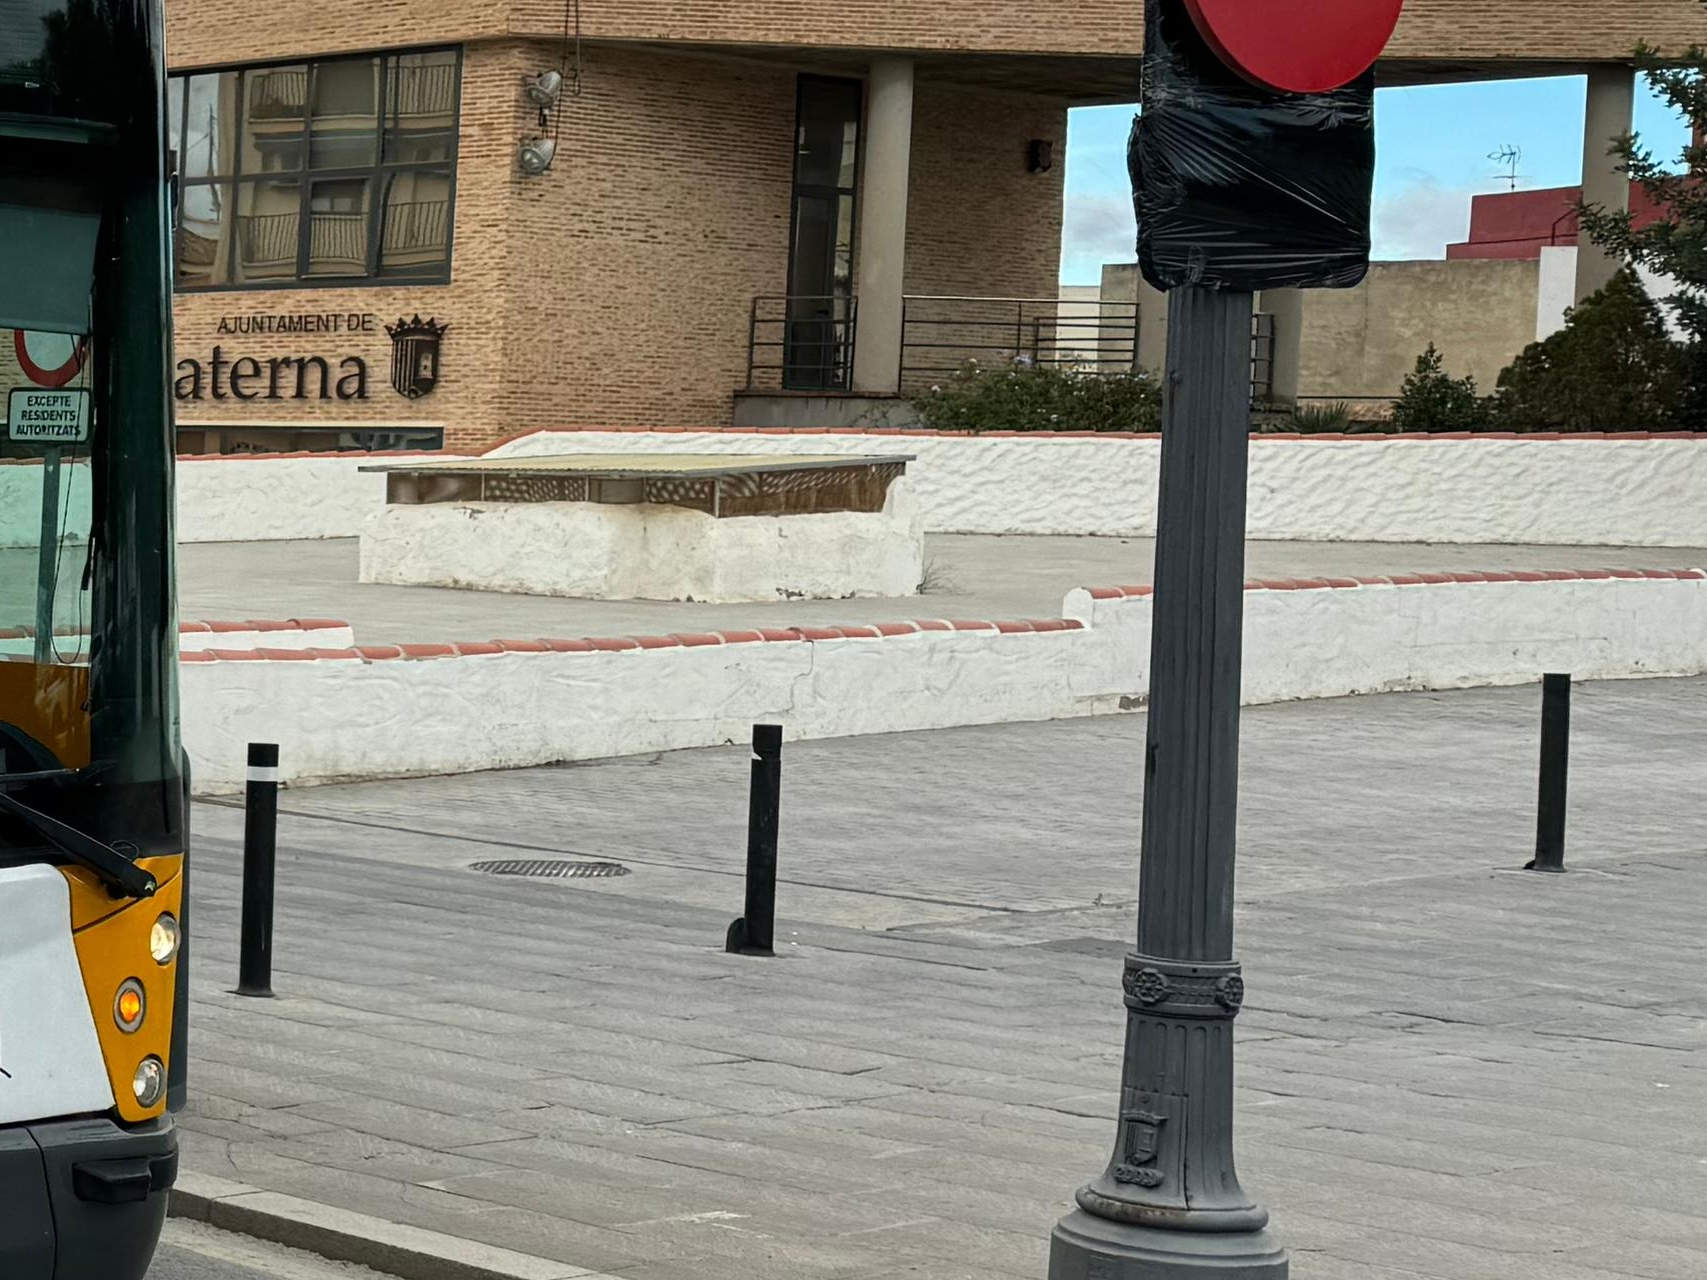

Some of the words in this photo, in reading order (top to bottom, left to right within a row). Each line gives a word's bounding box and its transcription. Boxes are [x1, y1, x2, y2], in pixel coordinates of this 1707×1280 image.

[217, 314, 342, 334] AJUNTAMENT
[347, 313, 374, 332] DE
[174, 344, 370, 401] aterna
[27, 395, 71, 407] EXCEPTE
[21, 409, 76, 421] RESIDENTS
[16, 424, 81, 436] AUTORITZATS
